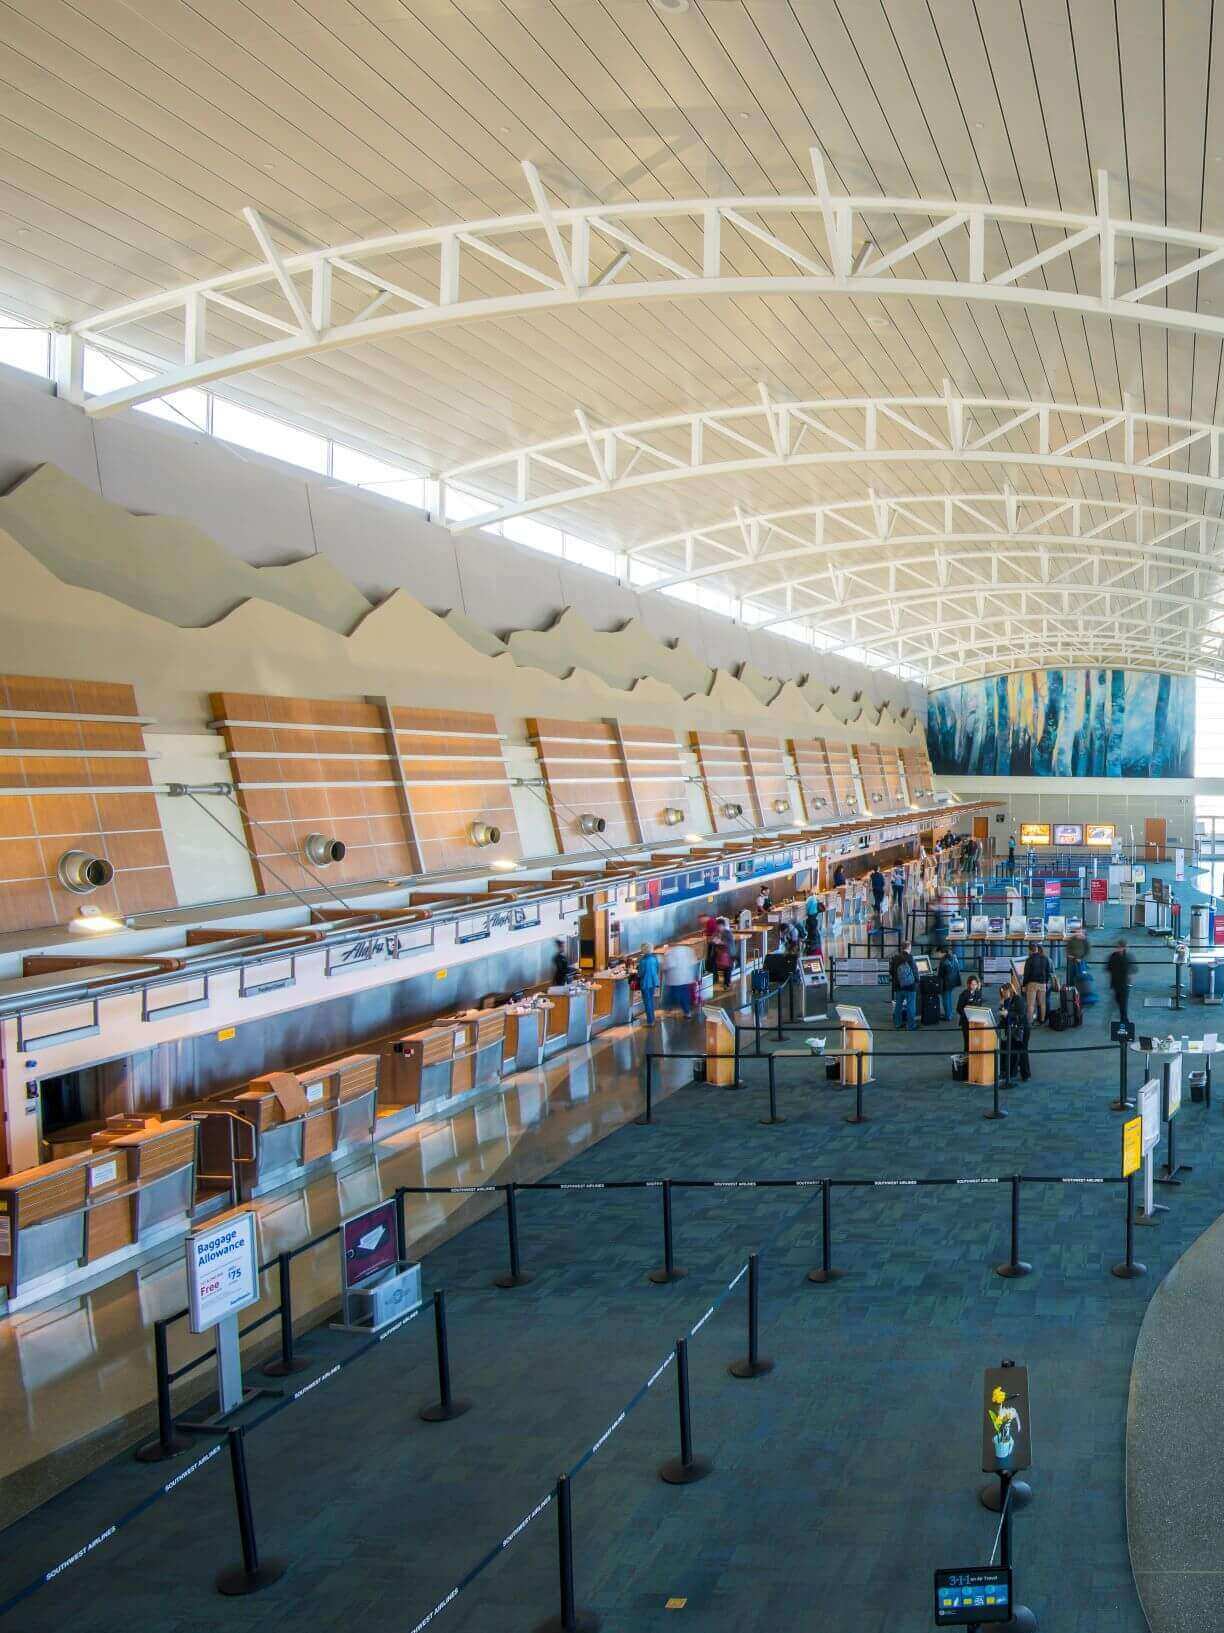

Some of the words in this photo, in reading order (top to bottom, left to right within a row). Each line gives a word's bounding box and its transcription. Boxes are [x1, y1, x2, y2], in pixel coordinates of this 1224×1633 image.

[342, 937, 385, 961] Alaka
[198, 1229, 237, 1255] Baggage
[198, 1238, 245, 1267] Allowance
[200, 1281, 220, 1296] Free
[165, 1463, 198, 1492] SOUTHWEST
[46, 1546, 88, 1581] SOUTHWEST
[87, 1525, 117, 1552] AIRLINES
